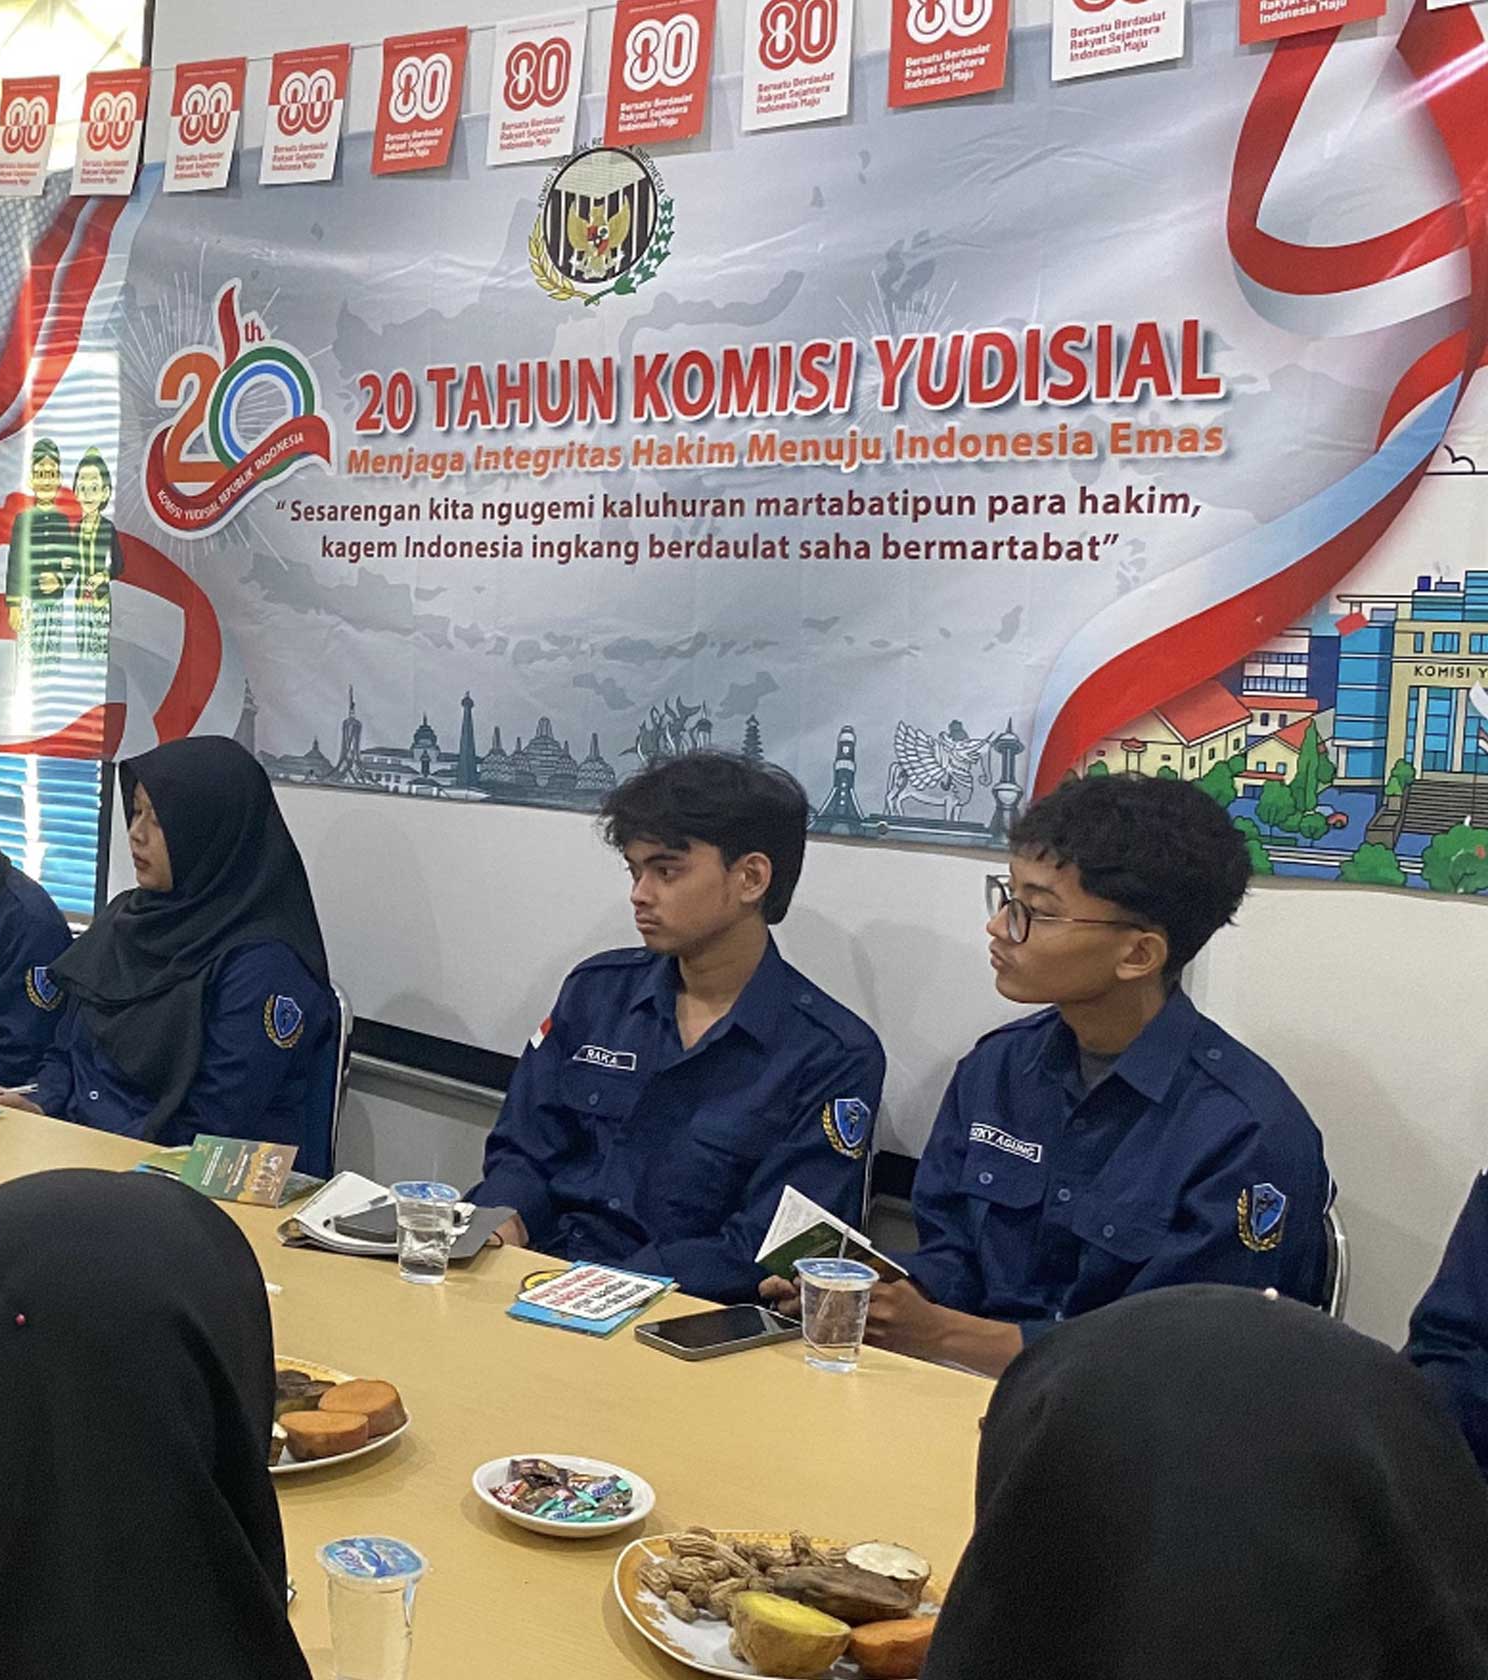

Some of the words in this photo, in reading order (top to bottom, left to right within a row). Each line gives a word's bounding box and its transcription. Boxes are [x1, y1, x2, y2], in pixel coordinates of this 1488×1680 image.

[759, 0, 838, 70] 80
[1070, 39, 1106, 52] Rakyat
[1109, 26, 1160, 45] Sejahtera
[1071, 25, 1110, 38] Bersatu
[1114, 11, 1166, 30] Berdaulat
[1260, 5, 1316, 24] Indonesia
[504, 37, 571, 111] 80
[623, 13, 700, 92] 80
[1070, 47, 1120, 62] Indonesia
[1123, 40, 1148, 54] Maju
[179, 81, 232, 145] 80
[278, 68, 336, 136] 80
[389, 53, 453, 123] 80
[2, 97, 49, 154] 80
[87, 91, 137, 151] 80
[355, 370, 415, 432] 20
[426, 357, 614, 429] TAHUN
[633, 341, 854, 419] KOMISI
[874, 318, 1222, 410] YUDISIAL
[254, 432, 304, 469] INDONESIA
[347, 447, 464, 480] Menjaga
[474, 439, 622, 478] Integritas
[632, 434, 735, 467] Hakim
[747, 427, 882, 467] Menuju
[895, 423, 1094, 459] Indonesia
[1110, 422, 1224, 455] Emas
[428, 497, 475, 522] kita
[482, 493, 595, 526] ngugemi
[603, 491, 745, 519] kaluhuran
[756, 489, 976, 523] martabatipun
[987, 490, 1066, 523] para
[1079, 485, 1202, 517] hakim,
[322, 535, 397, 563] kagem
[405, 534, 523, 559] Indonesia
[532, 532, 639, 565] ingkang
[648, 532, 789, 560] berdaulat
[798, 532, 871, 560] saha
[1414, 666, 1470, 678] KOMISI
[586, 1049, 617, 1064] RAKA
